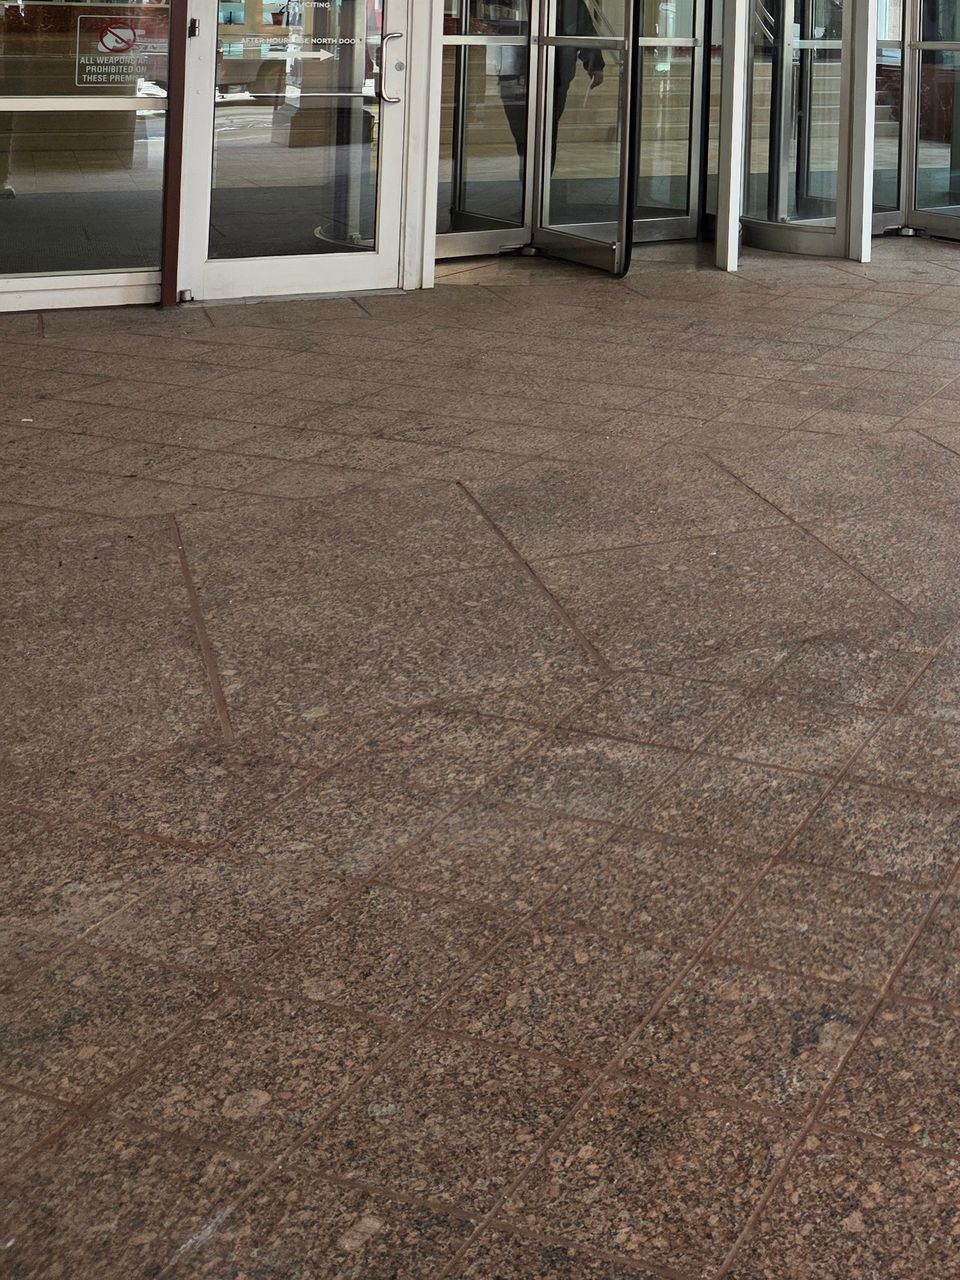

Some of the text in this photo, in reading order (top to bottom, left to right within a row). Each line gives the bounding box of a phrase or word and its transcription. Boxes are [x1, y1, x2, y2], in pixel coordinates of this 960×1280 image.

[311, 37, 337, 45] NORTH
[79, 56, 95, 64] ALL
[96, 56, 136, 64] WEAPONS
[85, 65, 134, 73] PROHIBITED
[82, 74, 150, 82] THESE PREMIS
